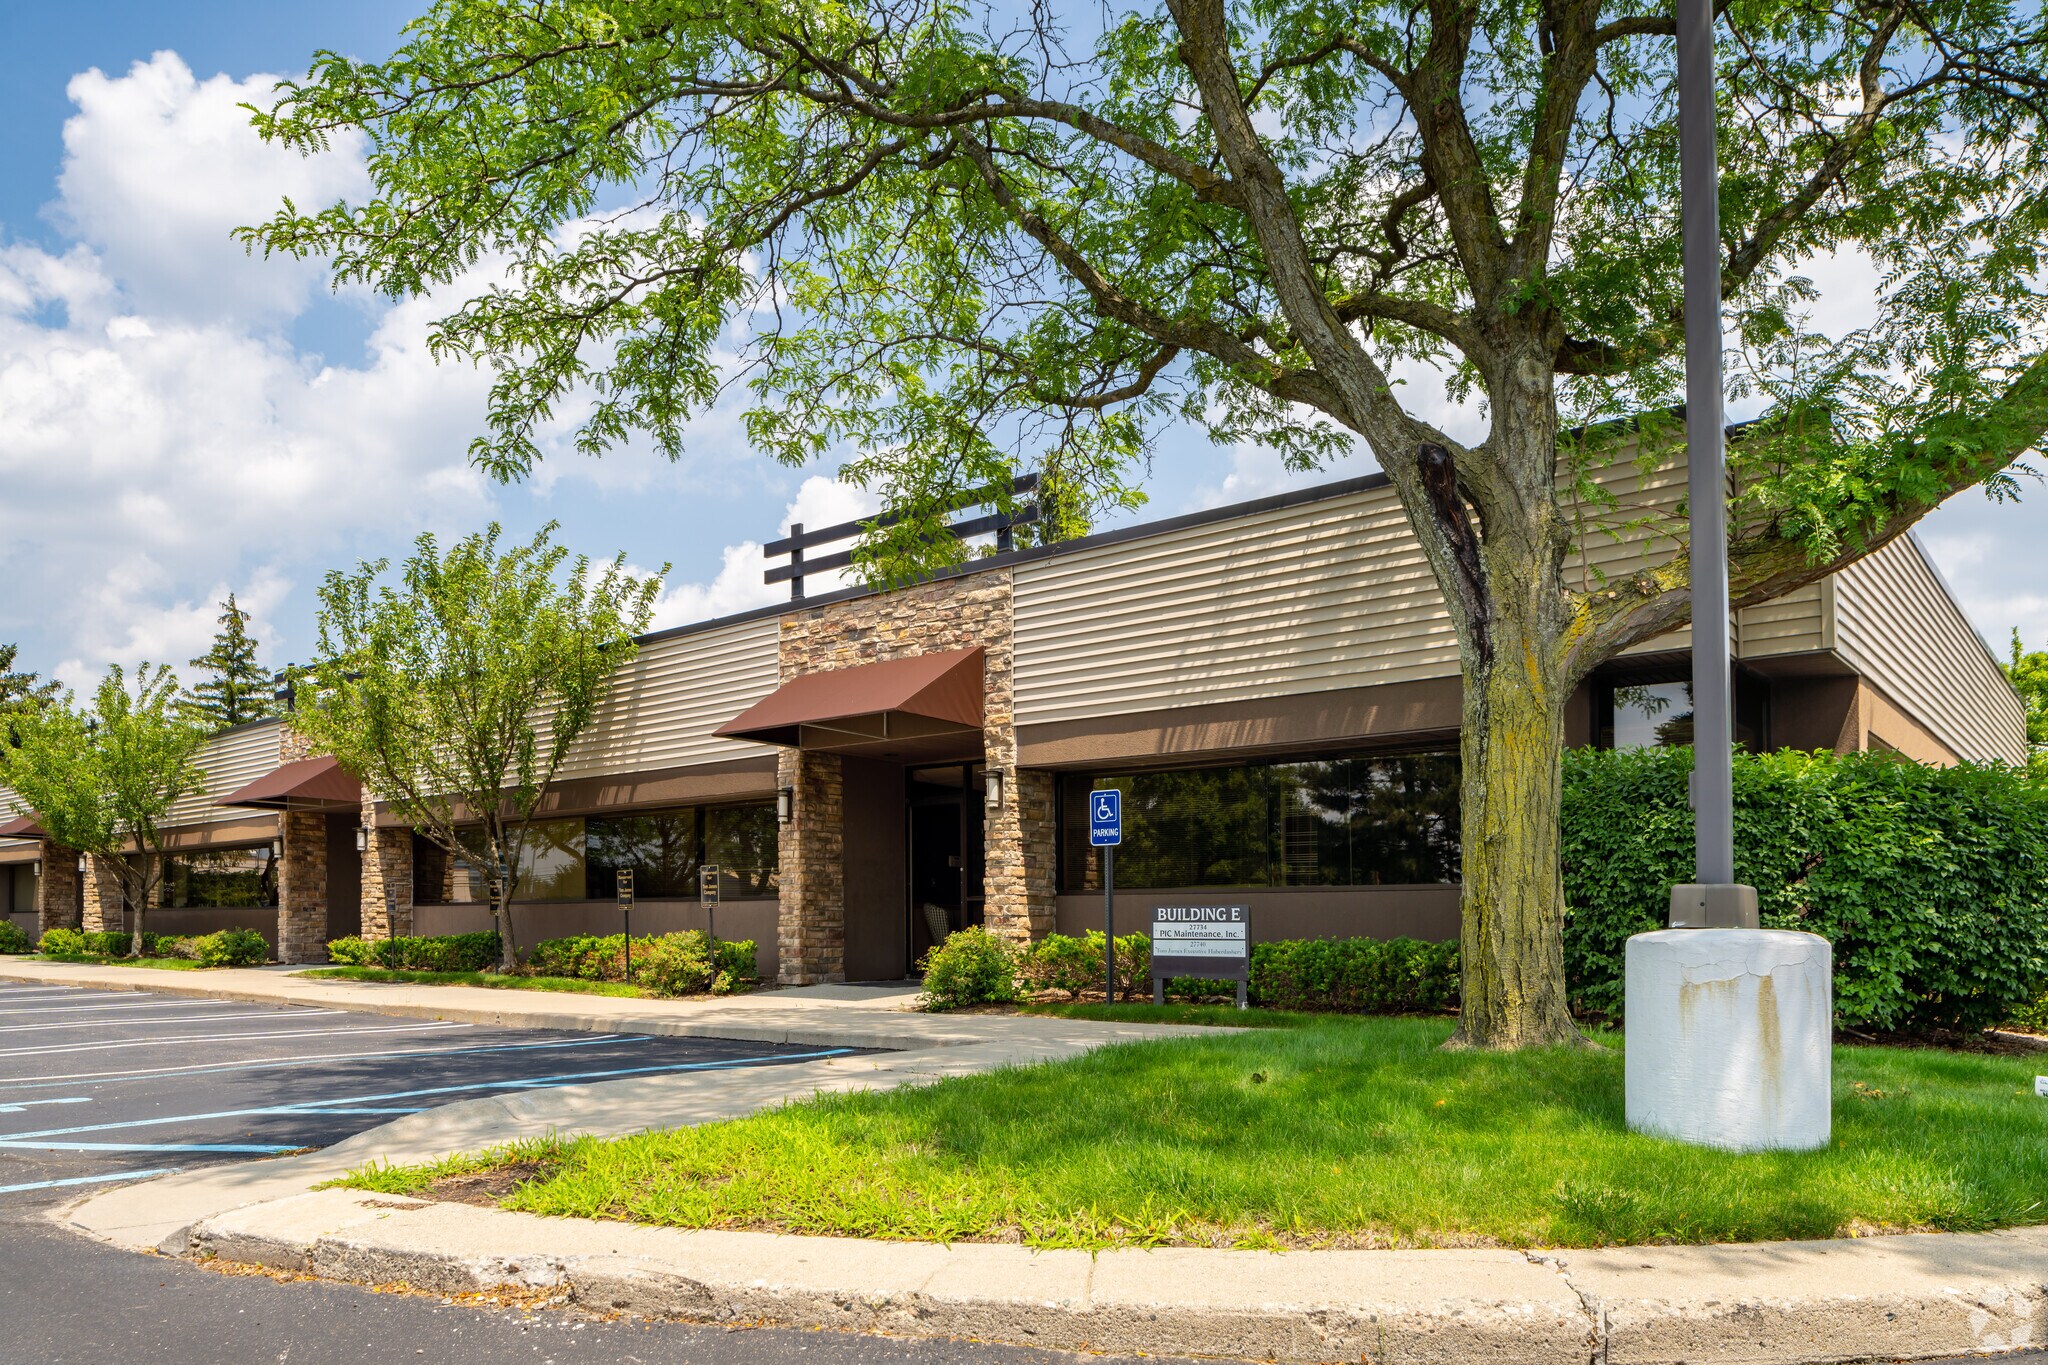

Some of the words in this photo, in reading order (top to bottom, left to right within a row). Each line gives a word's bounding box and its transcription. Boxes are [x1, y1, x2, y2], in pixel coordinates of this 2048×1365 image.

[1093, 828, 1118, 837] PARKING
[1157, 908, 1227, 921] BUILDING
[1231, 908, 1241, 921] E
[1173, 930, 1223, 938] Maintenance,
[1225, 930, 1240, 938] Inc.
